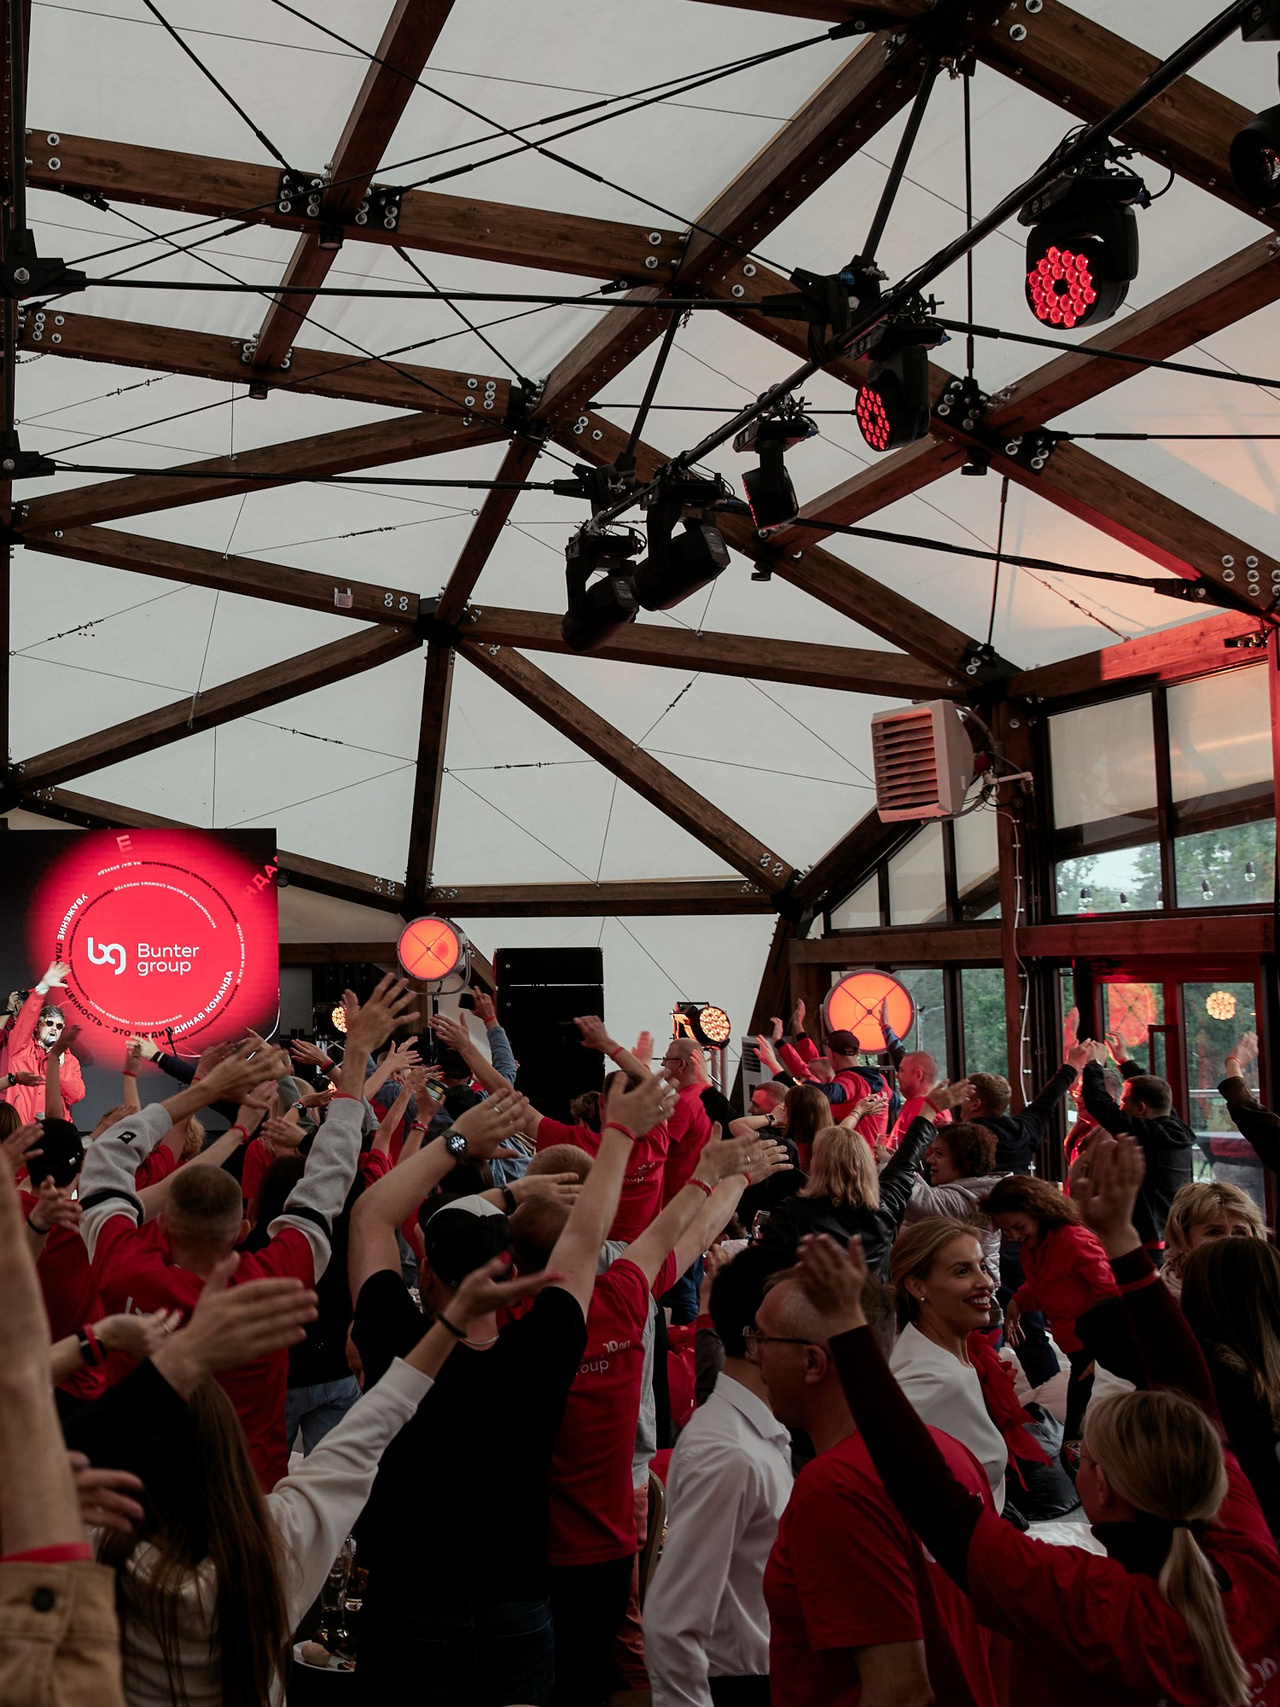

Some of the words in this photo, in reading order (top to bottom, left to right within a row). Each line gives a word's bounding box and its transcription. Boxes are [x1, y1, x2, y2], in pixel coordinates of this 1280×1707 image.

[56, 891, 89, 941] УВАЖЕНИЕ
[137, 943, 199, 958] Bunter
[137, 961, 192, 977] group
[63, 985, 104, 1027] ЦЕННОСТЬ
[111, 1025, 131, 1037] ЭТО
[170, 1011, 205, 1035] ДИНАЯ
[203, 969, 233, 1014] КОМАНДА
